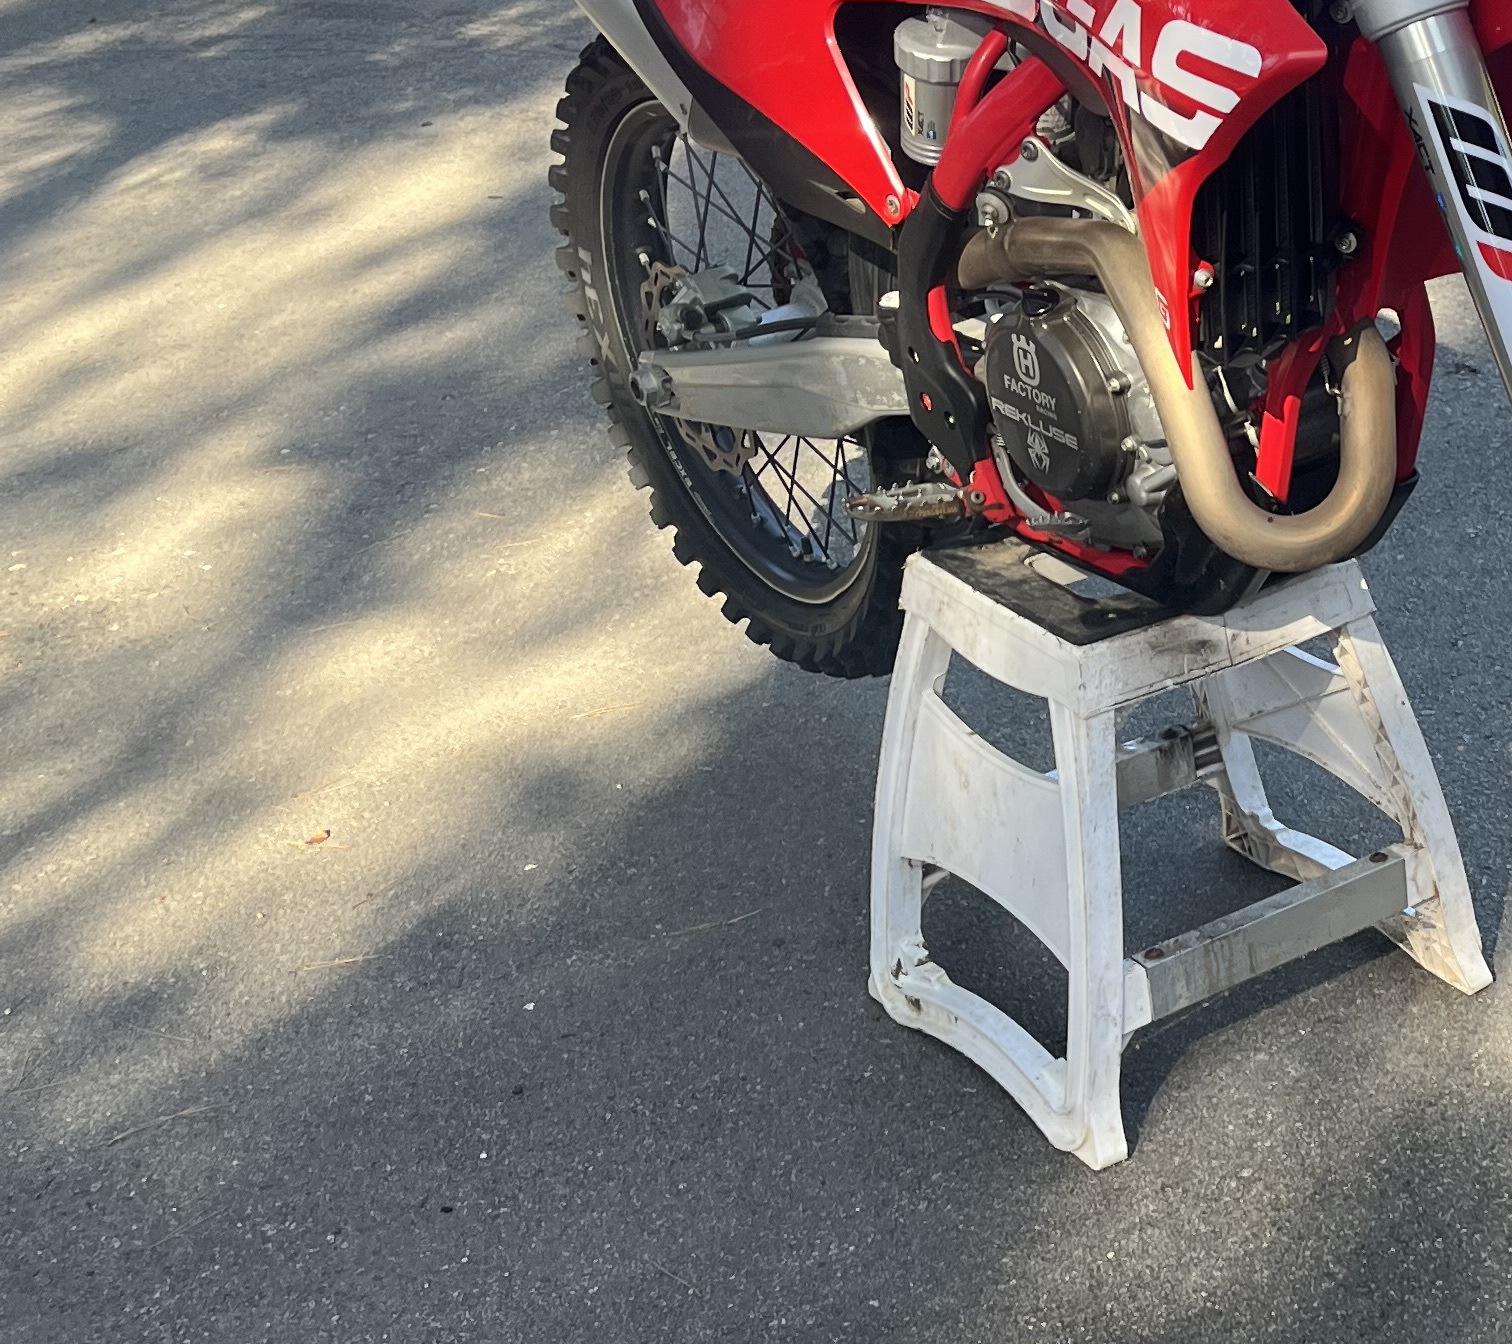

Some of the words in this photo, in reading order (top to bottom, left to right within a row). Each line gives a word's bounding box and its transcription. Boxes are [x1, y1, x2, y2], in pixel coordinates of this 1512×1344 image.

[1405, 107, 1436, 175] XACT
[1003, 373, 1056, 412] FACTORY
[991, 396, 1079, 451] REKLUSE
